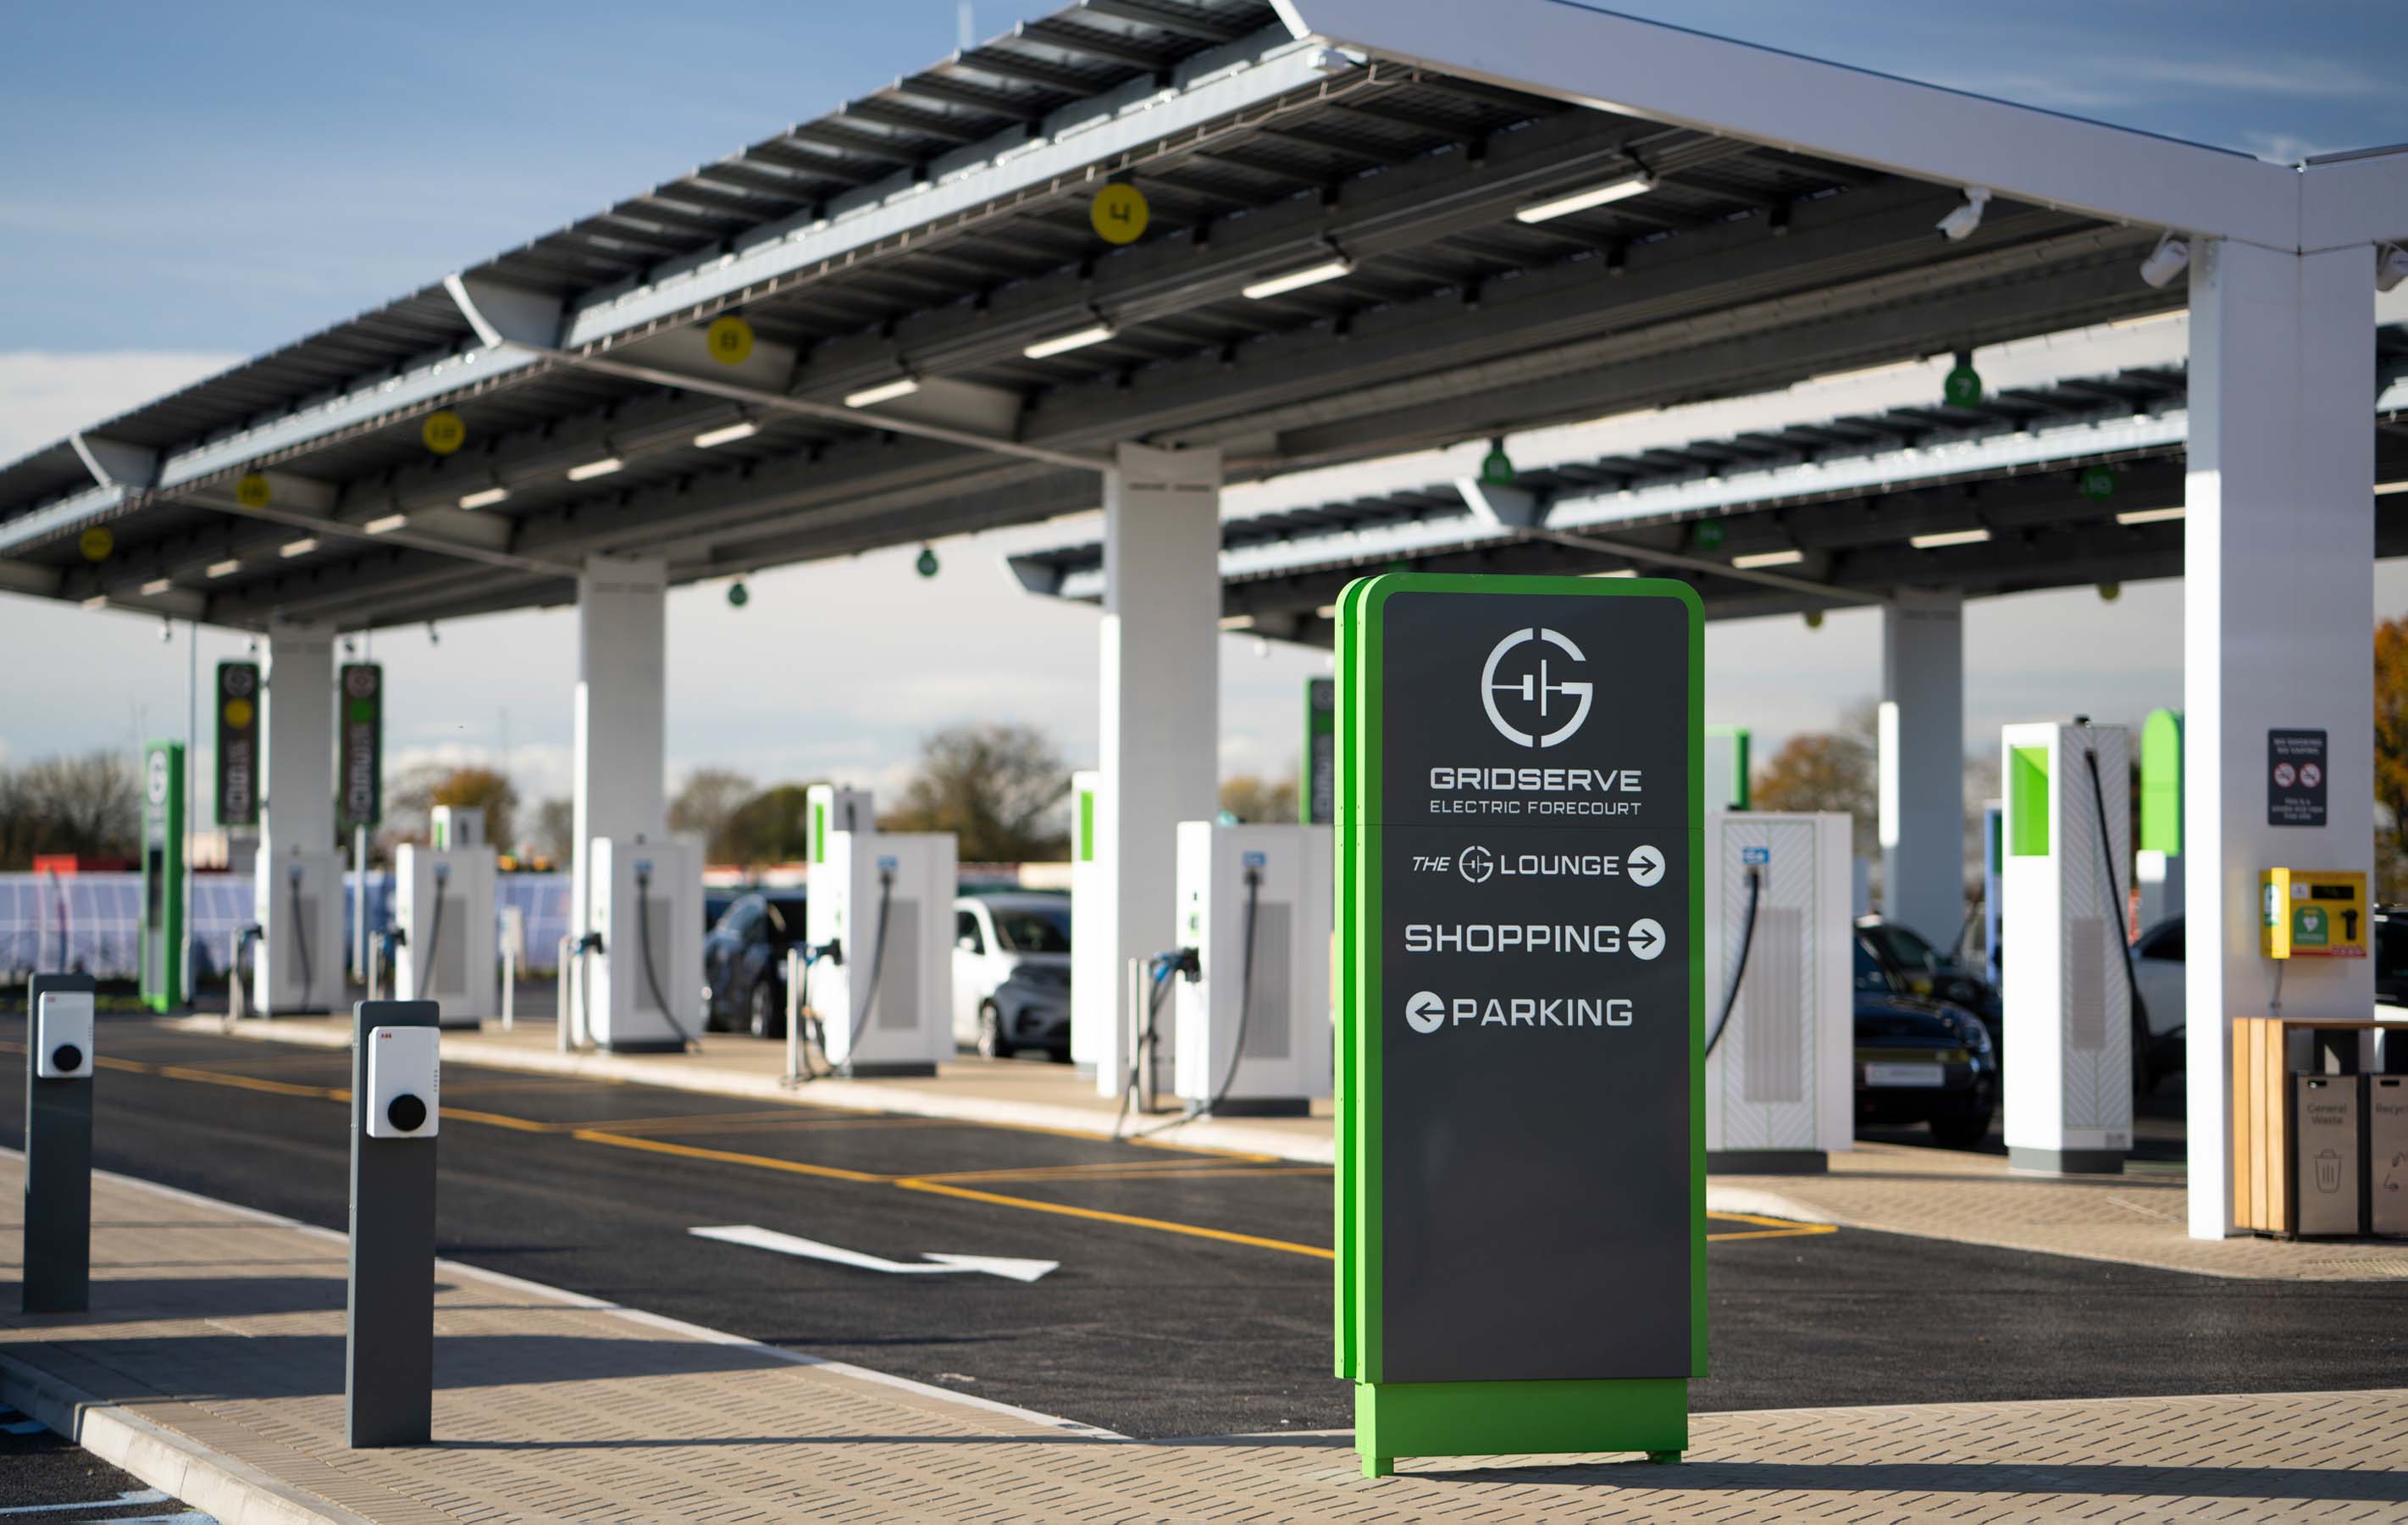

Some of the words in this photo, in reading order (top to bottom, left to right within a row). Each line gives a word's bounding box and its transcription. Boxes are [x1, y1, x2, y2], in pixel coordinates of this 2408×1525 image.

[1430, 767, 1642, 792] GRIDSERVE
[1430, 800, 1520, 814] ELECTRIC
[1528, 801, 1641, 815] FORECOURT
[1412, 856, 1451, 872] THE
[1500, 855, 1619, 875] LOUNGE
[1405, 924, 1620, 953] SHOPPING
[1453, 998, 1633, 1026] PARKING
[2306, 1103, 2347, 1114] General
[2311, 1116, 2343, 1125] Waste
